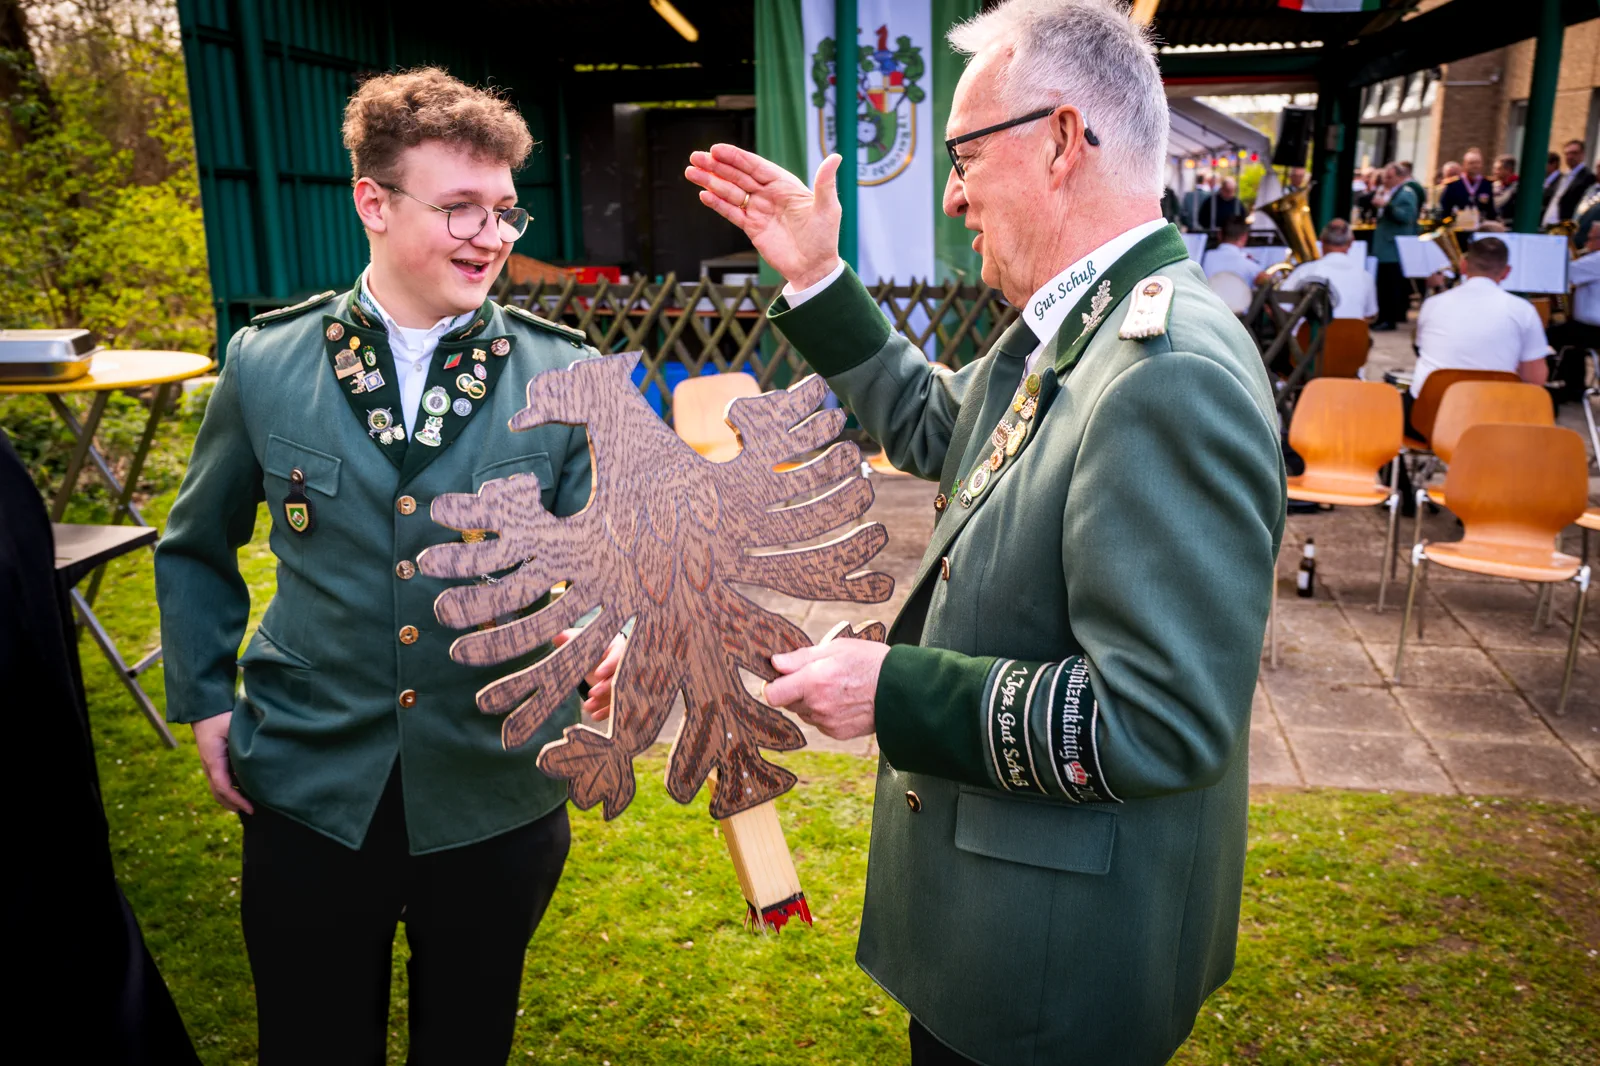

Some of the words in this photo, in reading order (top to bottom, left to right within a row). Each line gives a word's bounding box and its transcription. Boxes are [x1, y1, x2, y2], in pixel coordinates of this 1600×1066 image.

[1034, 292, 1057, 321] Gut
[1057, 260, 1097, 299] Schuß
[997, 712, 1016, 744] Gut
[1003, 748, 1029, 787] Schuß
